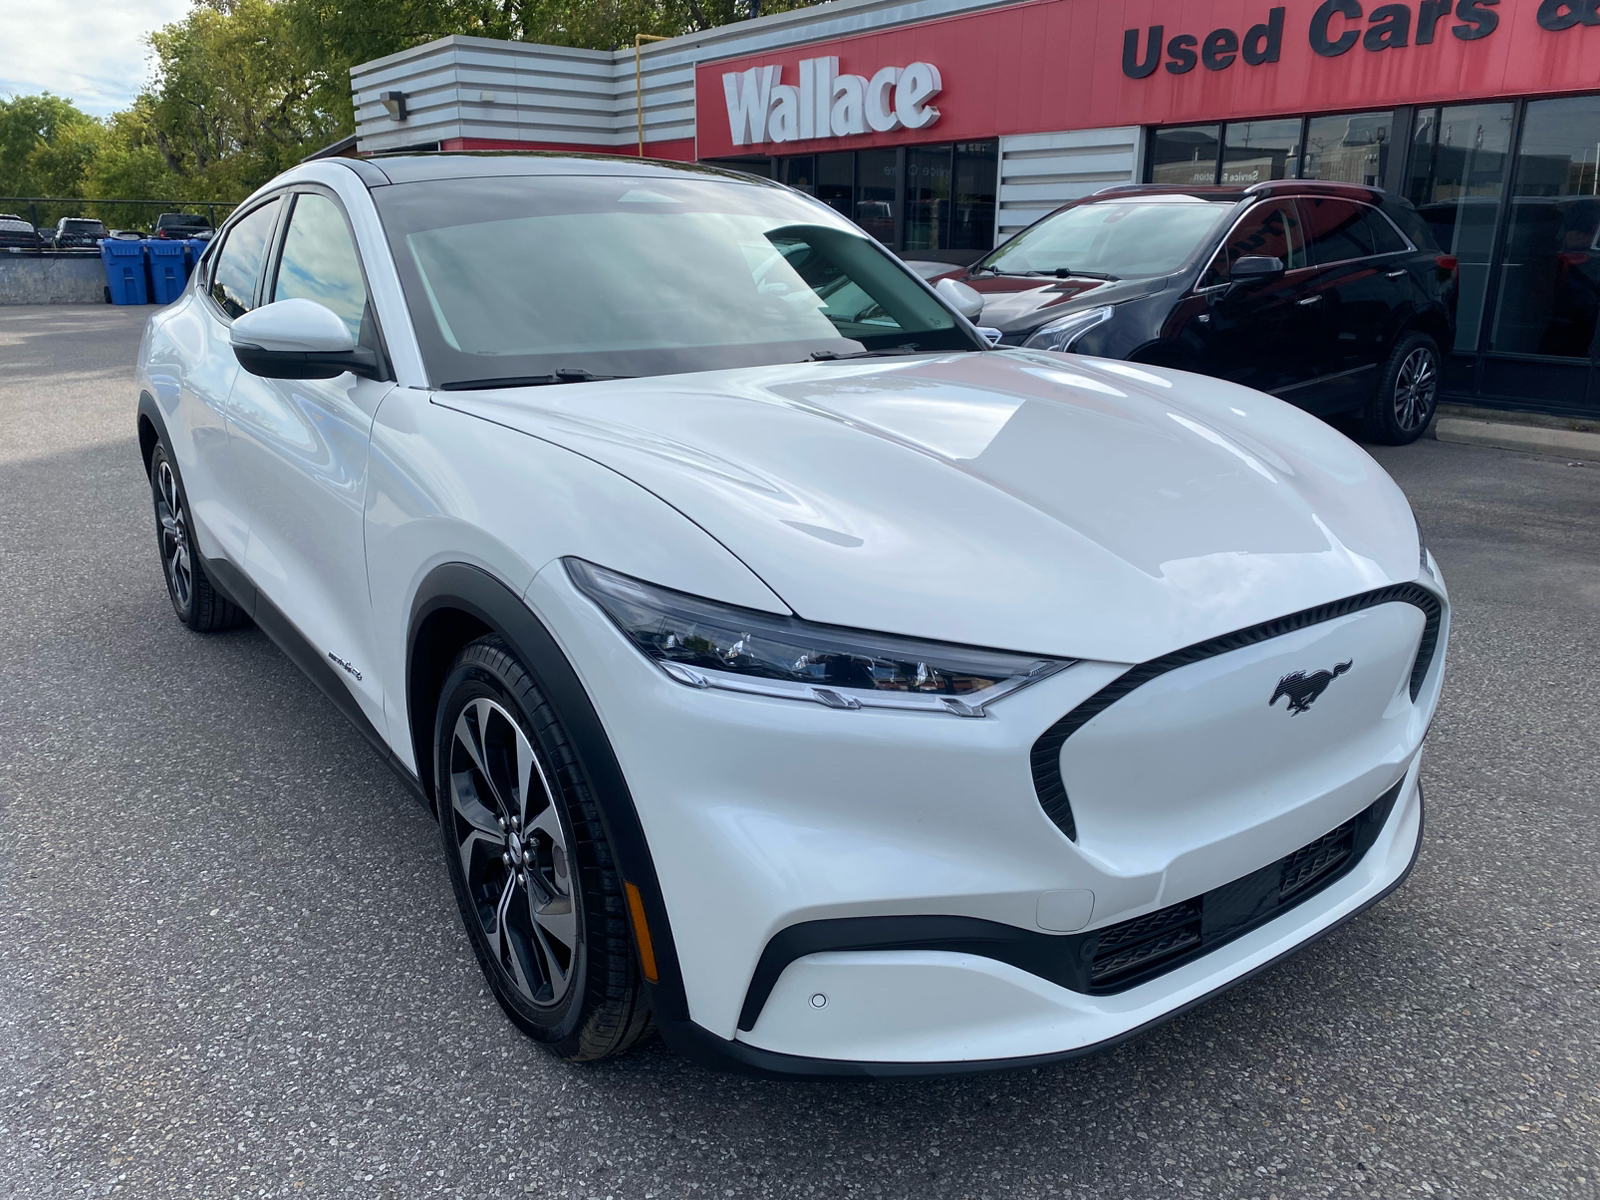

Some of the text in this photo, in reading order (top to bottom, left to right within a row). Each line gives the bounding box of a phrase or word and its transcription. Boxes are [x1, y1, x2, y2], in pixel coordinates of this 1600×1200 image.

[1122, 6, 1286, 79] Used
[1309, 0, 1500, 57] Cars
[722, 55, 943, 146] Wallace
